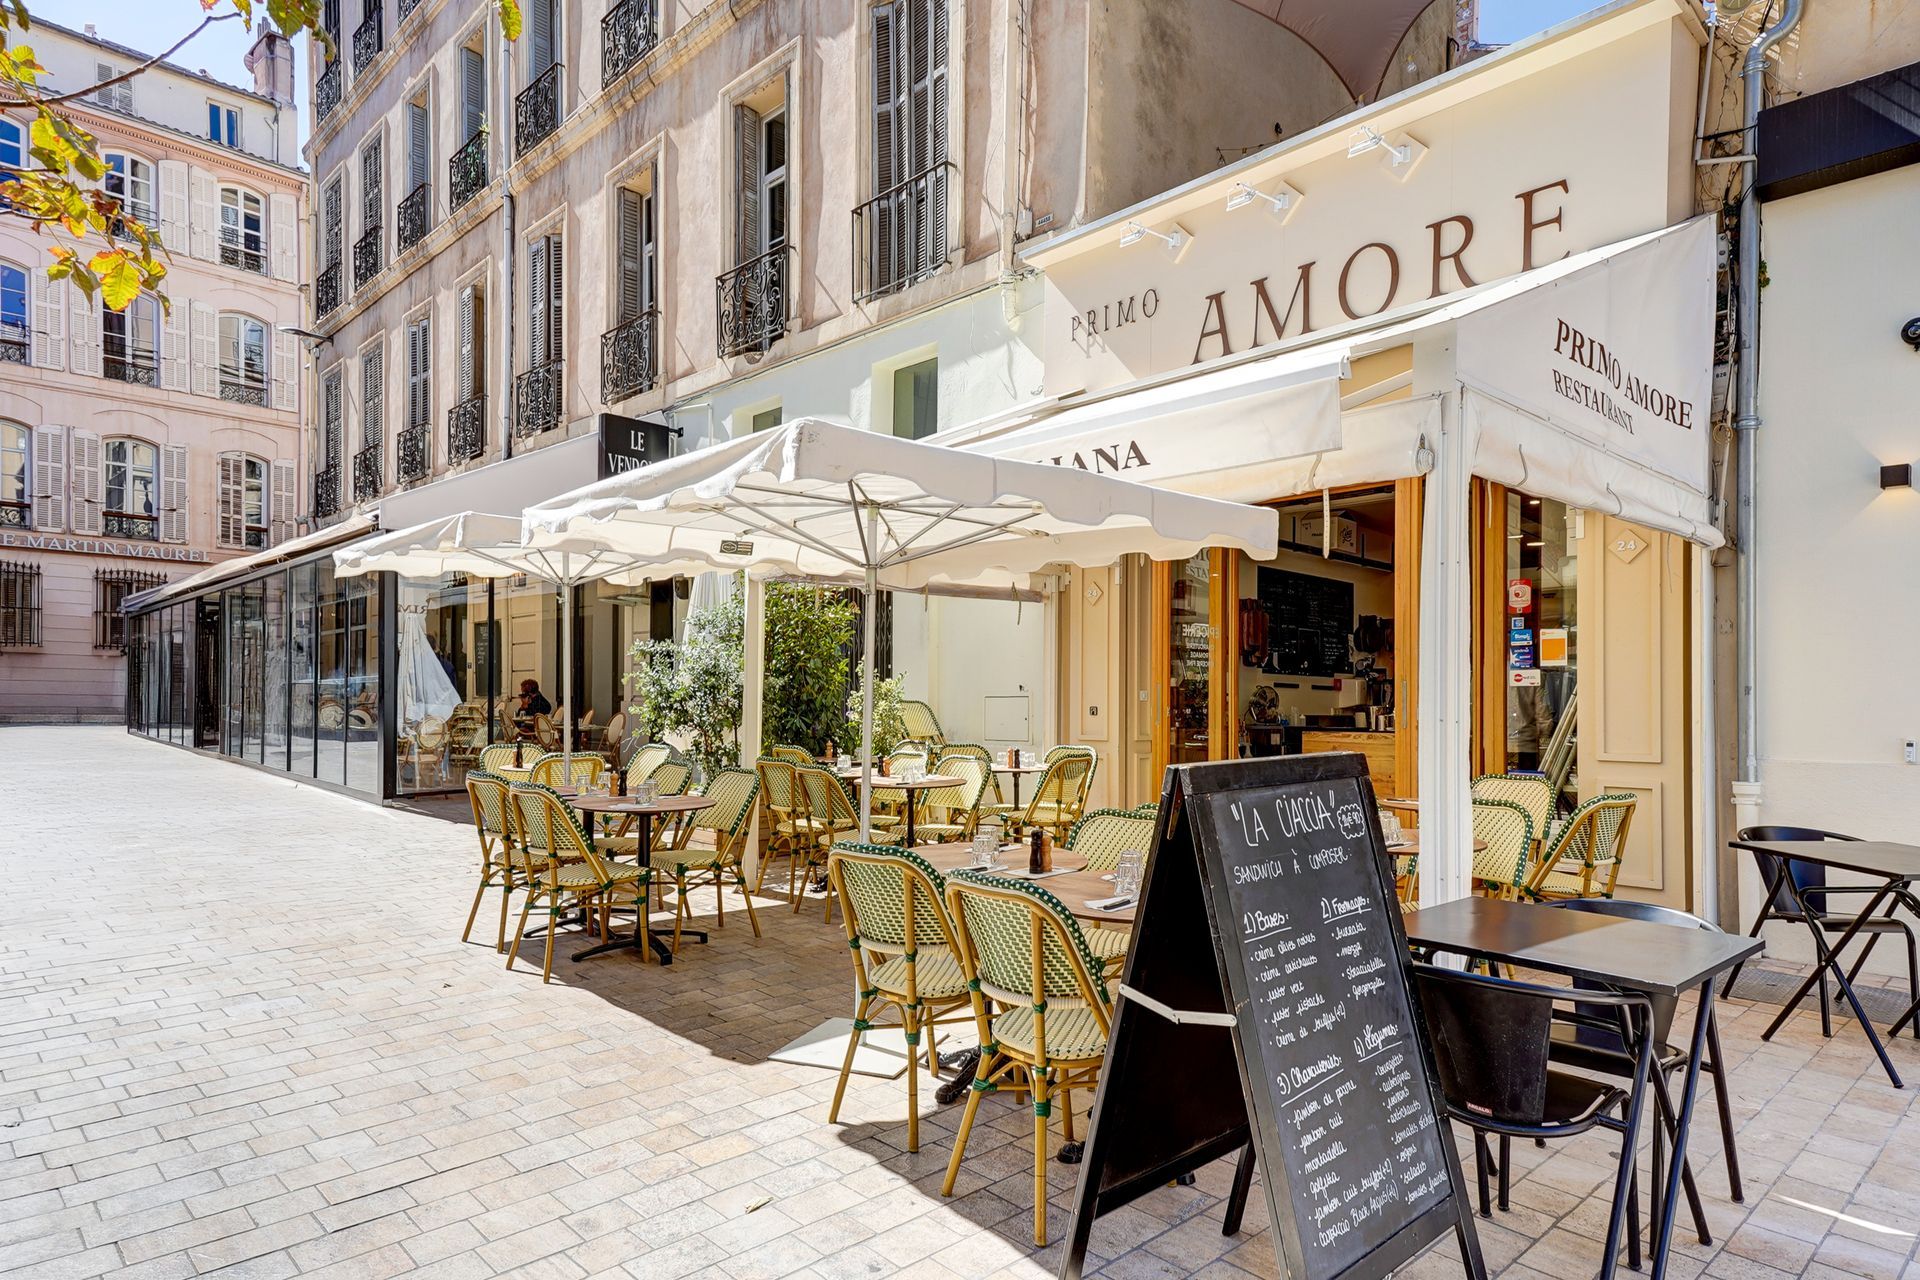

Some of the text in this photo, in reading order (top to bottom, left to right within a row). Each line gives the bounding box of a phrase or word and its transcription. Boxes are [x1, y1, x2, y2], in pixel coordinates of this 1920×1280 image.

[1071, 178, 1571, 366] PRIMO AMORE
[1552, 368, 1635, 435] RESTAURANT
[1624, 371, 1693, 430] AMORE
[630, 430, 645, 451] LE
[608, 453, 652, 473] VEND
[1036, 440, 1151, 474] ANA
[27, 535, 119, 555] MARTIN
[122, 544, 214, 563] MAUREL
[1616, 540, 1637, 551] 24
[1299, 1026, 1309, 1039] de
[1328, 1111, 1344, 1129] cuit
[1343, 1183, 1358, 1203] cuit
